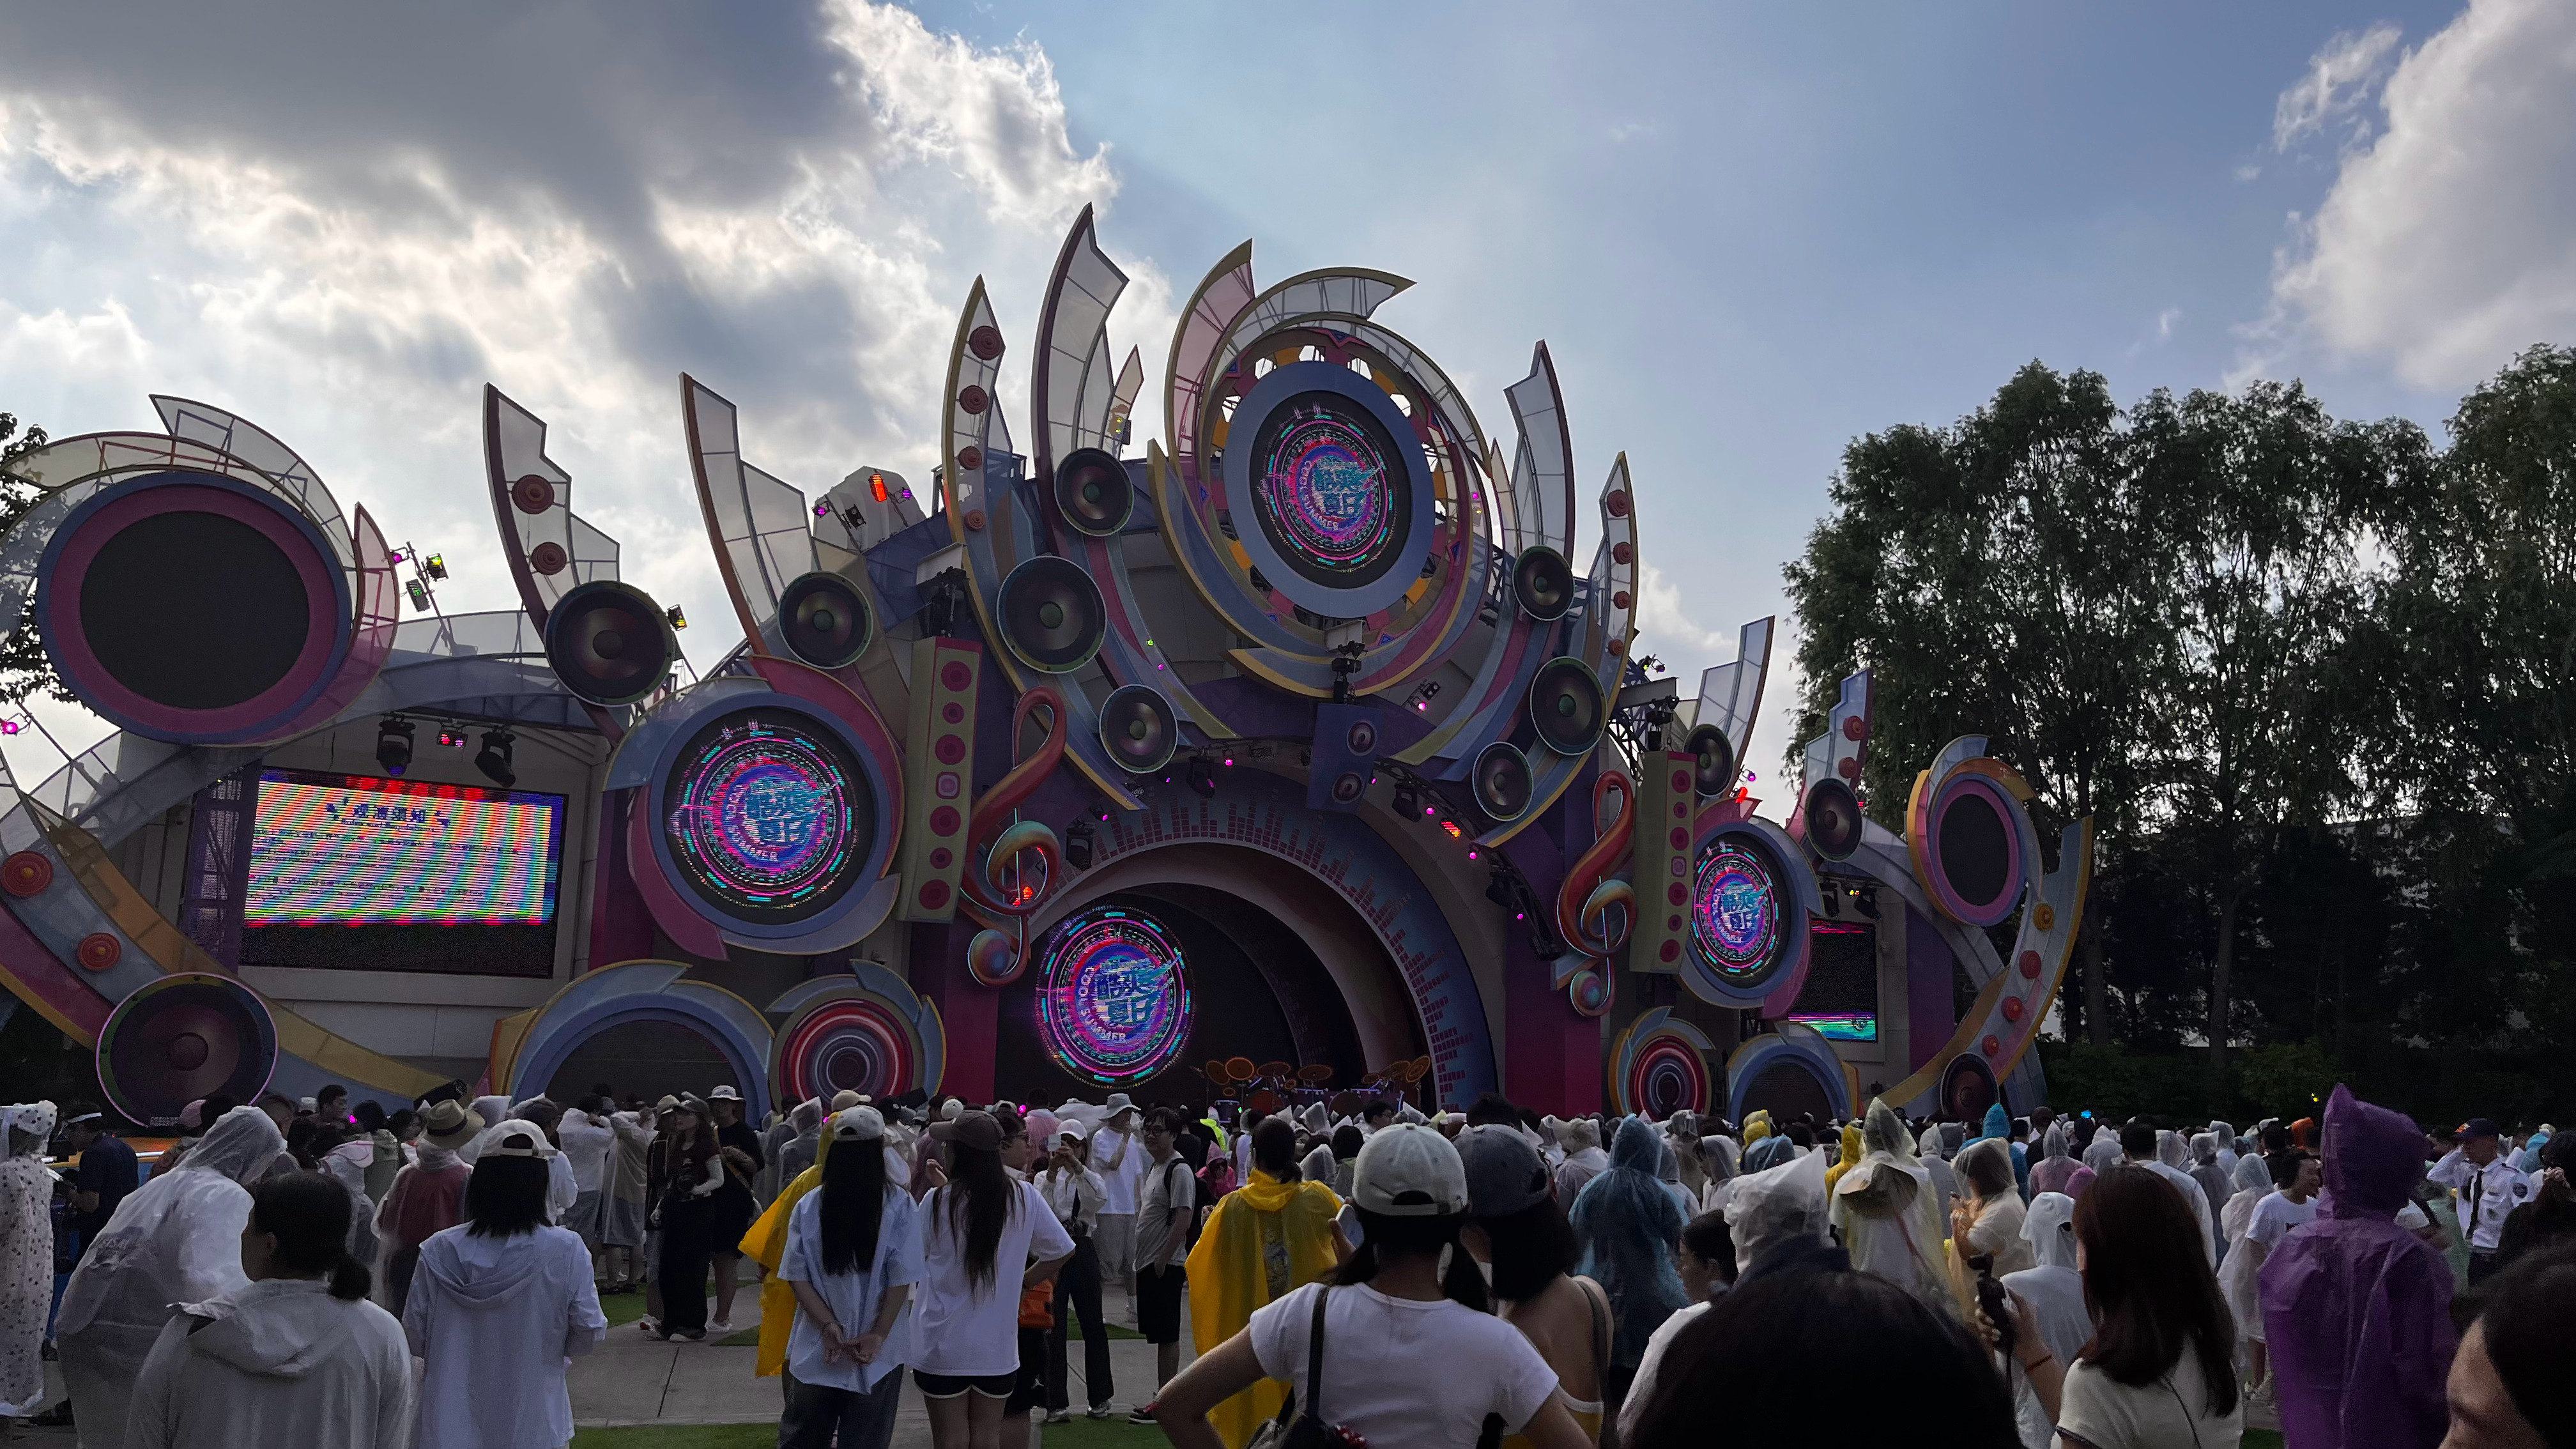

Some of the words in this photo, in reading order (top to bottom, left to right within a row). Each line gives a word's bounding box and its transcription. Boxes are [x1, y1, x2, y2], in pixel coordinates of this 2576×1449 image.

[1299, 460, 1312, 491] COOL
[1303, 494, 1339, 531] SUMMER
[726, 784, 745, 821] COOL
[1078, 967, 1095, 1004] COOL
[1080, 1008, 1126, 1042] SUMMER
